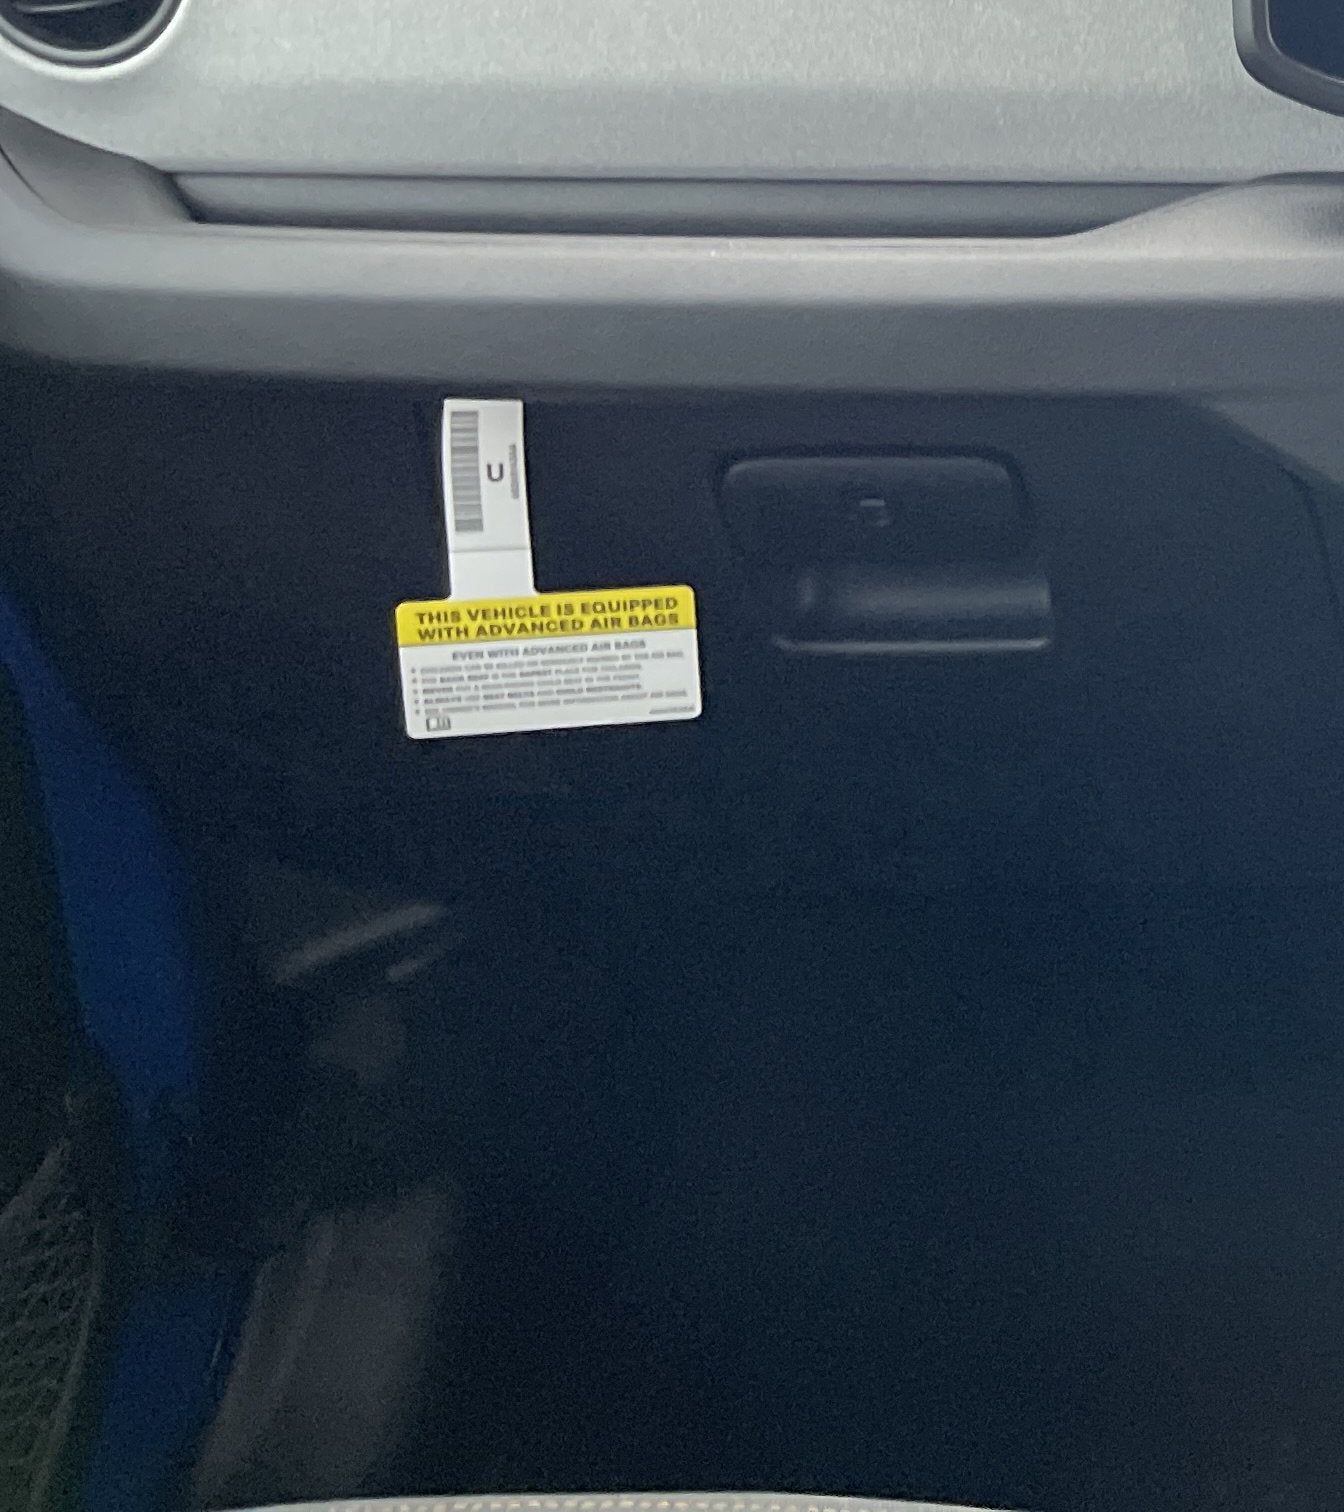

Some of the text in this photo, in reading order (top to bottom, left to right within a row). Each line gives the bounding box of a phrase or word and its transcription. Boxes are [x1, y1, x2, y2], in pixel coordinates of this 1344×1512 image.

[416, 597, 678, 624] THIS VEHICLE IS EQUIPPED
[418, 613, 679, 639] WITH ADVANCED AIR BAGS
